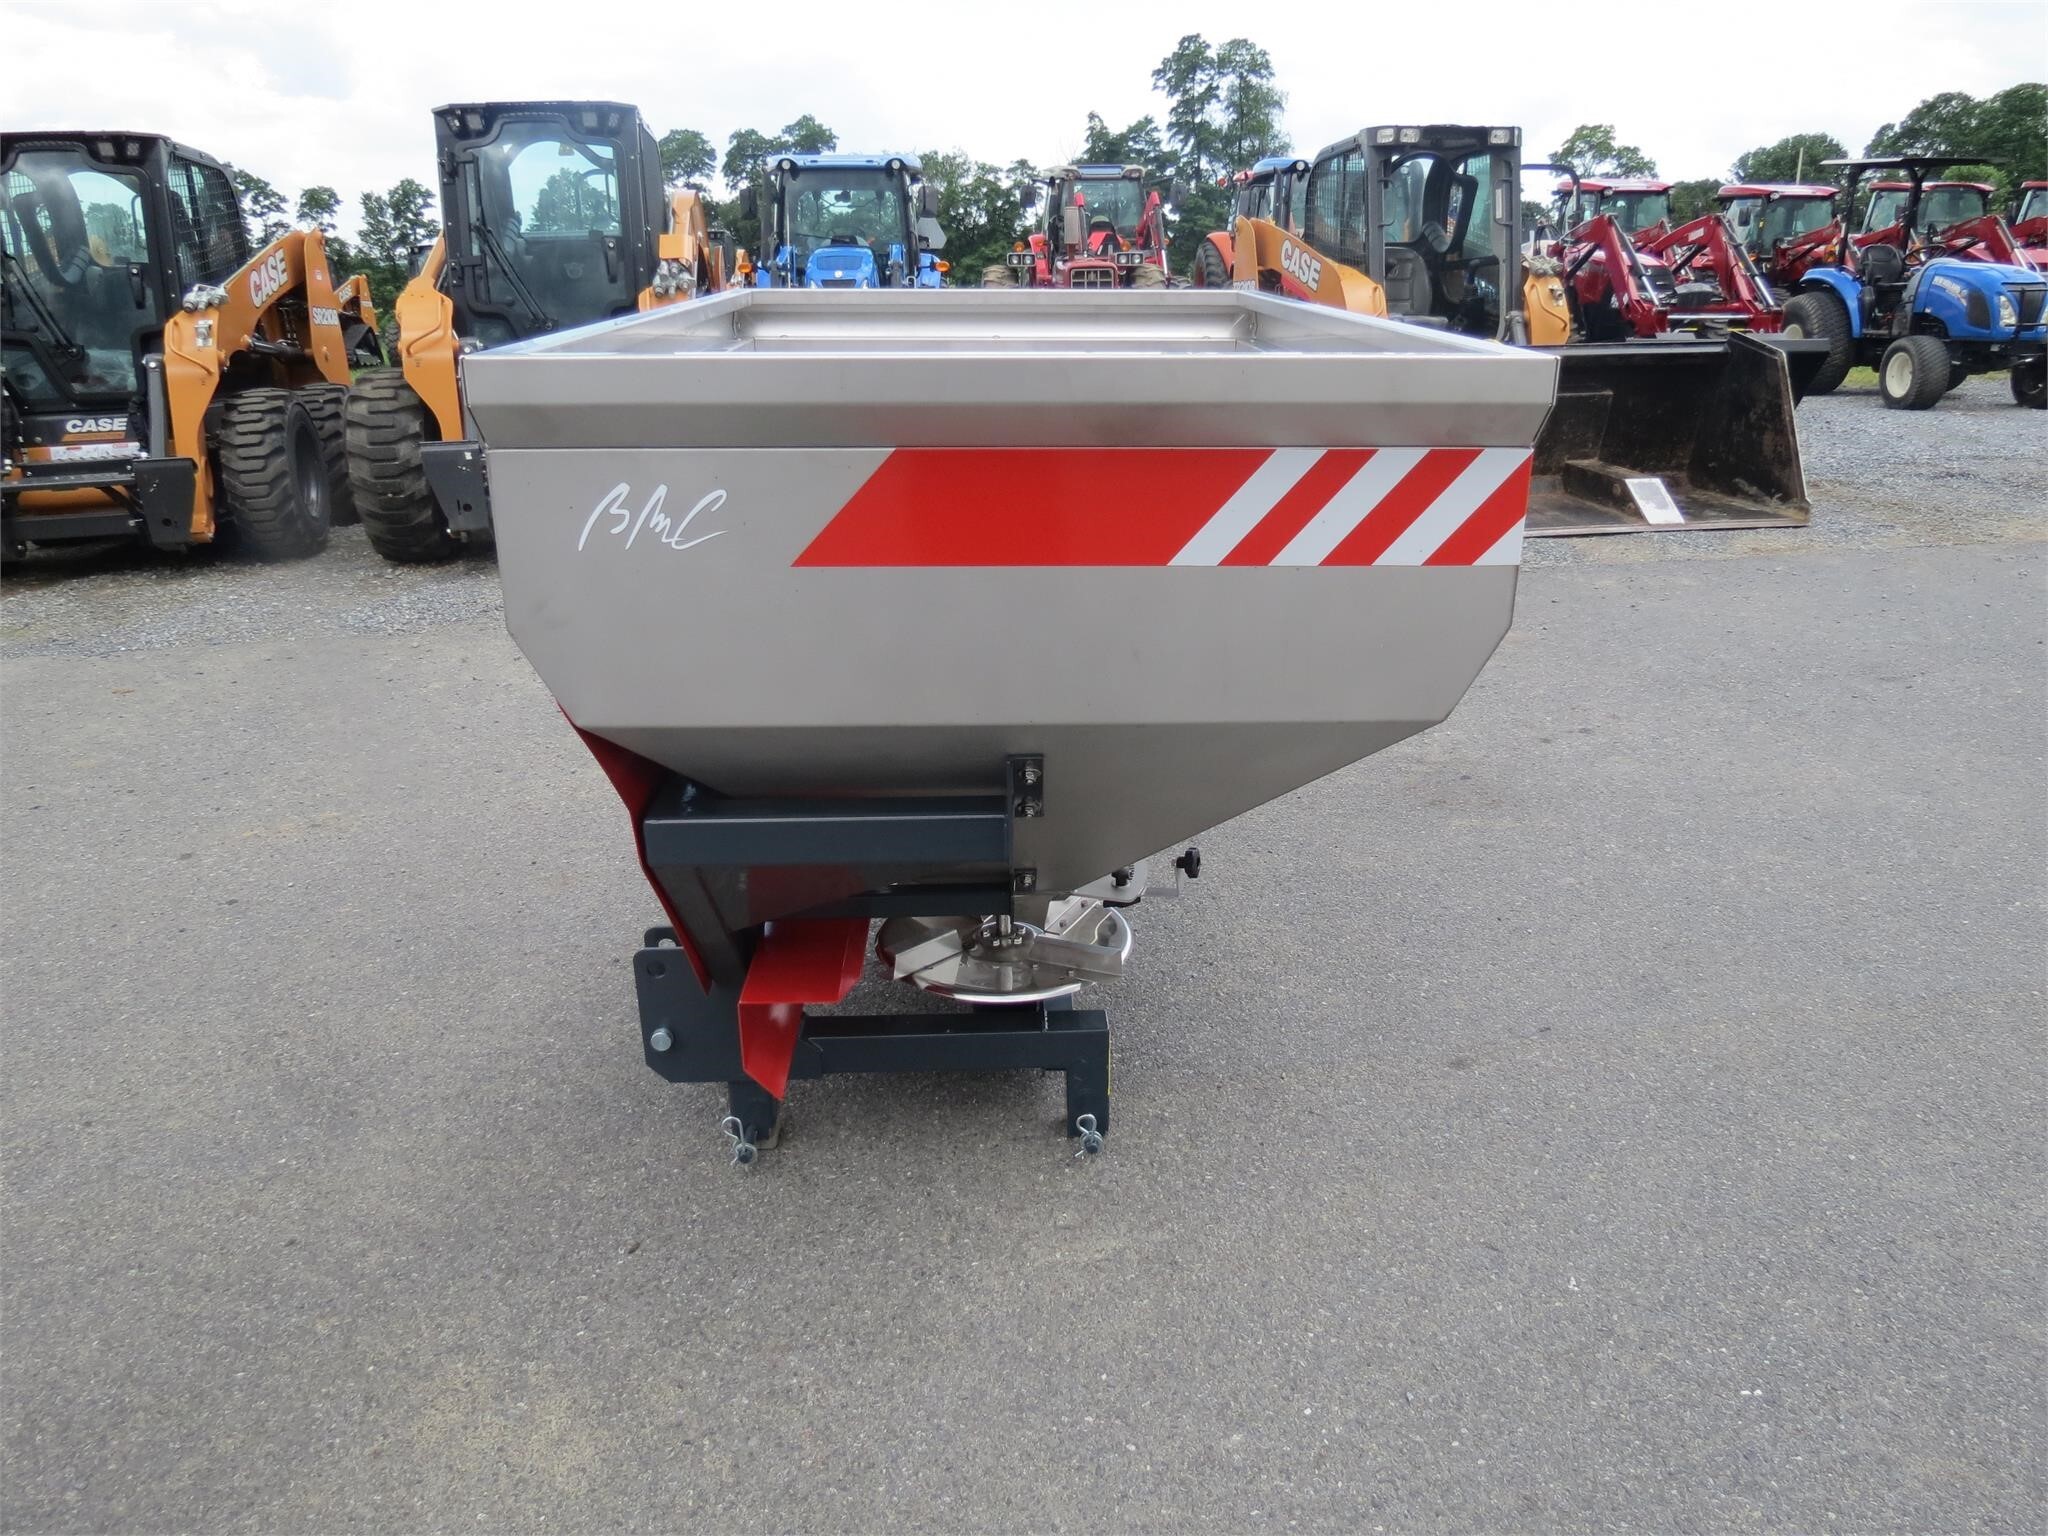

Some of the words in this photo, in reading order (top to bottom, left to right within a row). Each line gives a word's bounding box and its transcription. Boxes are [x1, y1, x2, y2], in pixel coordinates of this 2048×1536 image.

[250, 247, 288, 308] CASE
[1281, 239, 1321, 291] CASE
[65, 417, 128, 433] CASE
